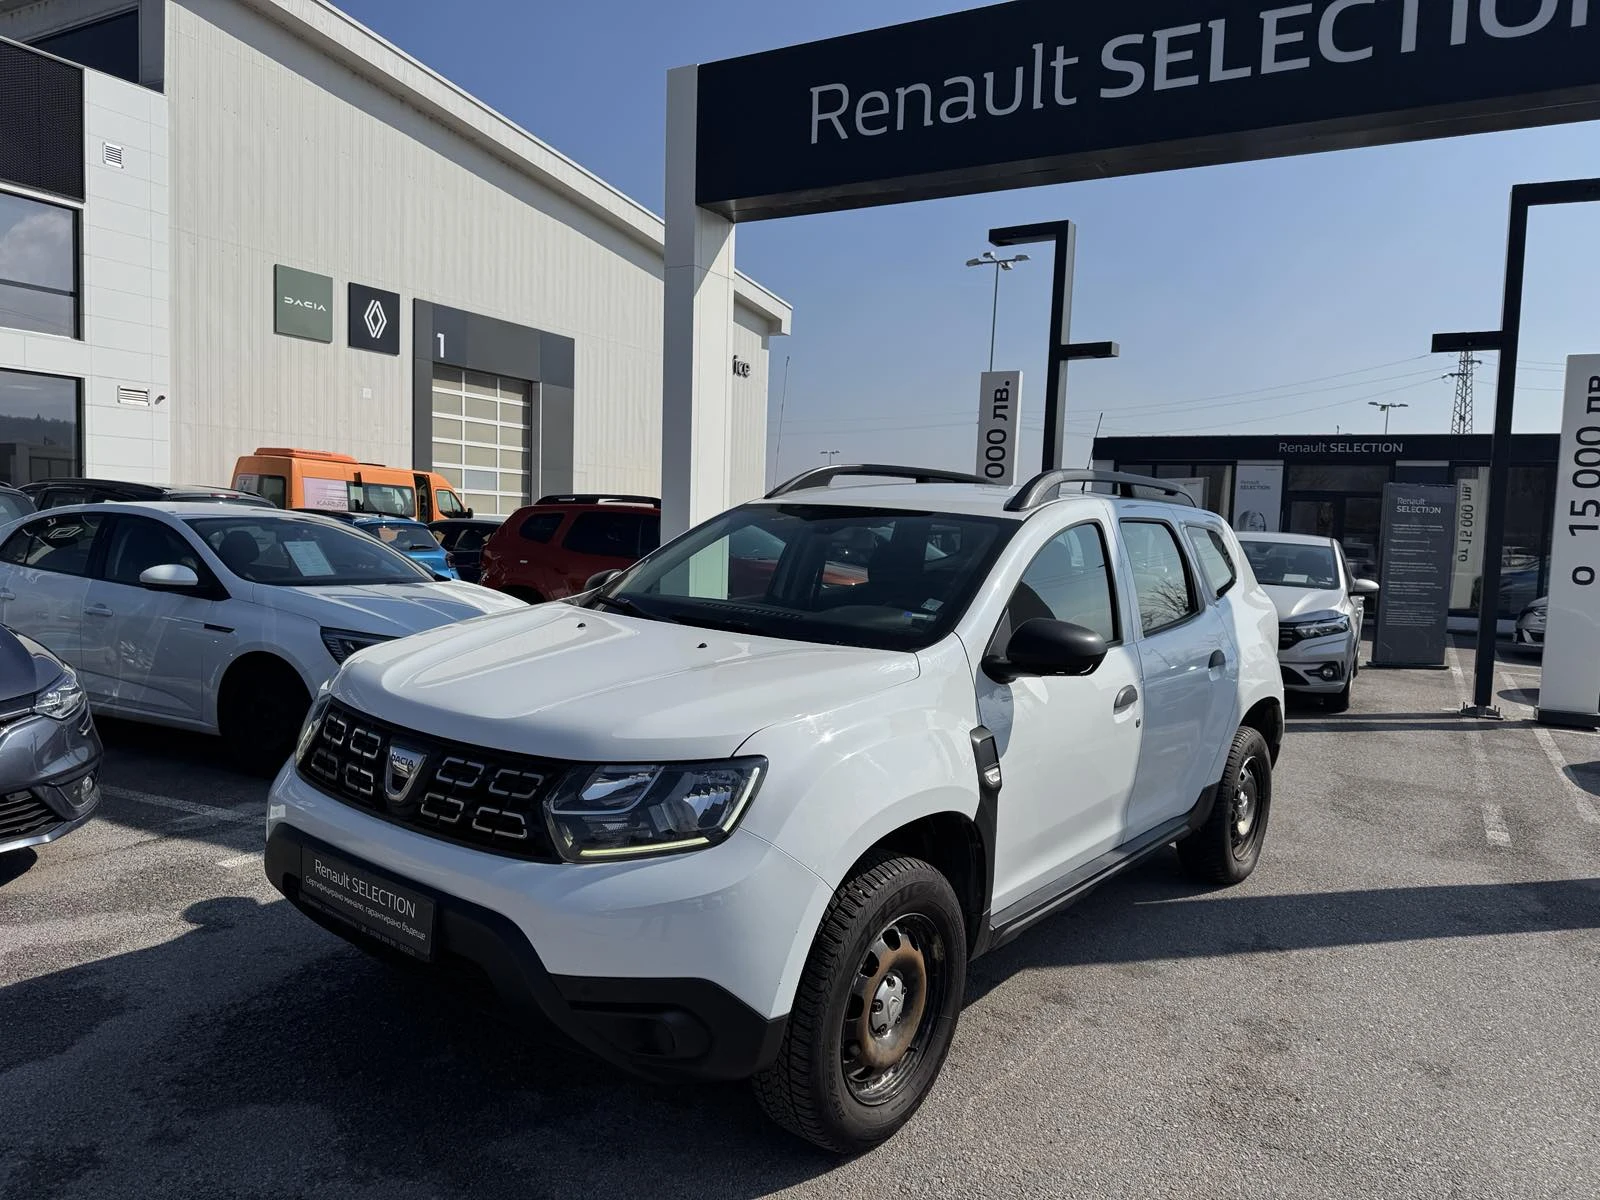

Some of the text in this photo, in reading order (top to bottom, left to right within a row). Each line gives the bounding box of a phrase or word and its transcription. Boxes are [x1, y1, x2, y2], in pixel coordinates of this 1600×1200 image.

[810, 43, 1079, 144] Renault
[284, 296, 326, 312] DACIA
[437, 333, 444, 358] 1
[985, 429, 1007, 478] 000
[1279, 442, 1403, 453] Renault SELECTION
[1572, 426, 1600, 488] 000
[1396, 505, 1441, 514] SELECTION
[1397, 496, 1425, 505] Renault
[1568, 500, 1600, 536] 15
[391, 754, 414, 768] DACIA
[314, 859, 416, 918] Renault SELECTION
[402, 922, 426, 941] бъдеще
